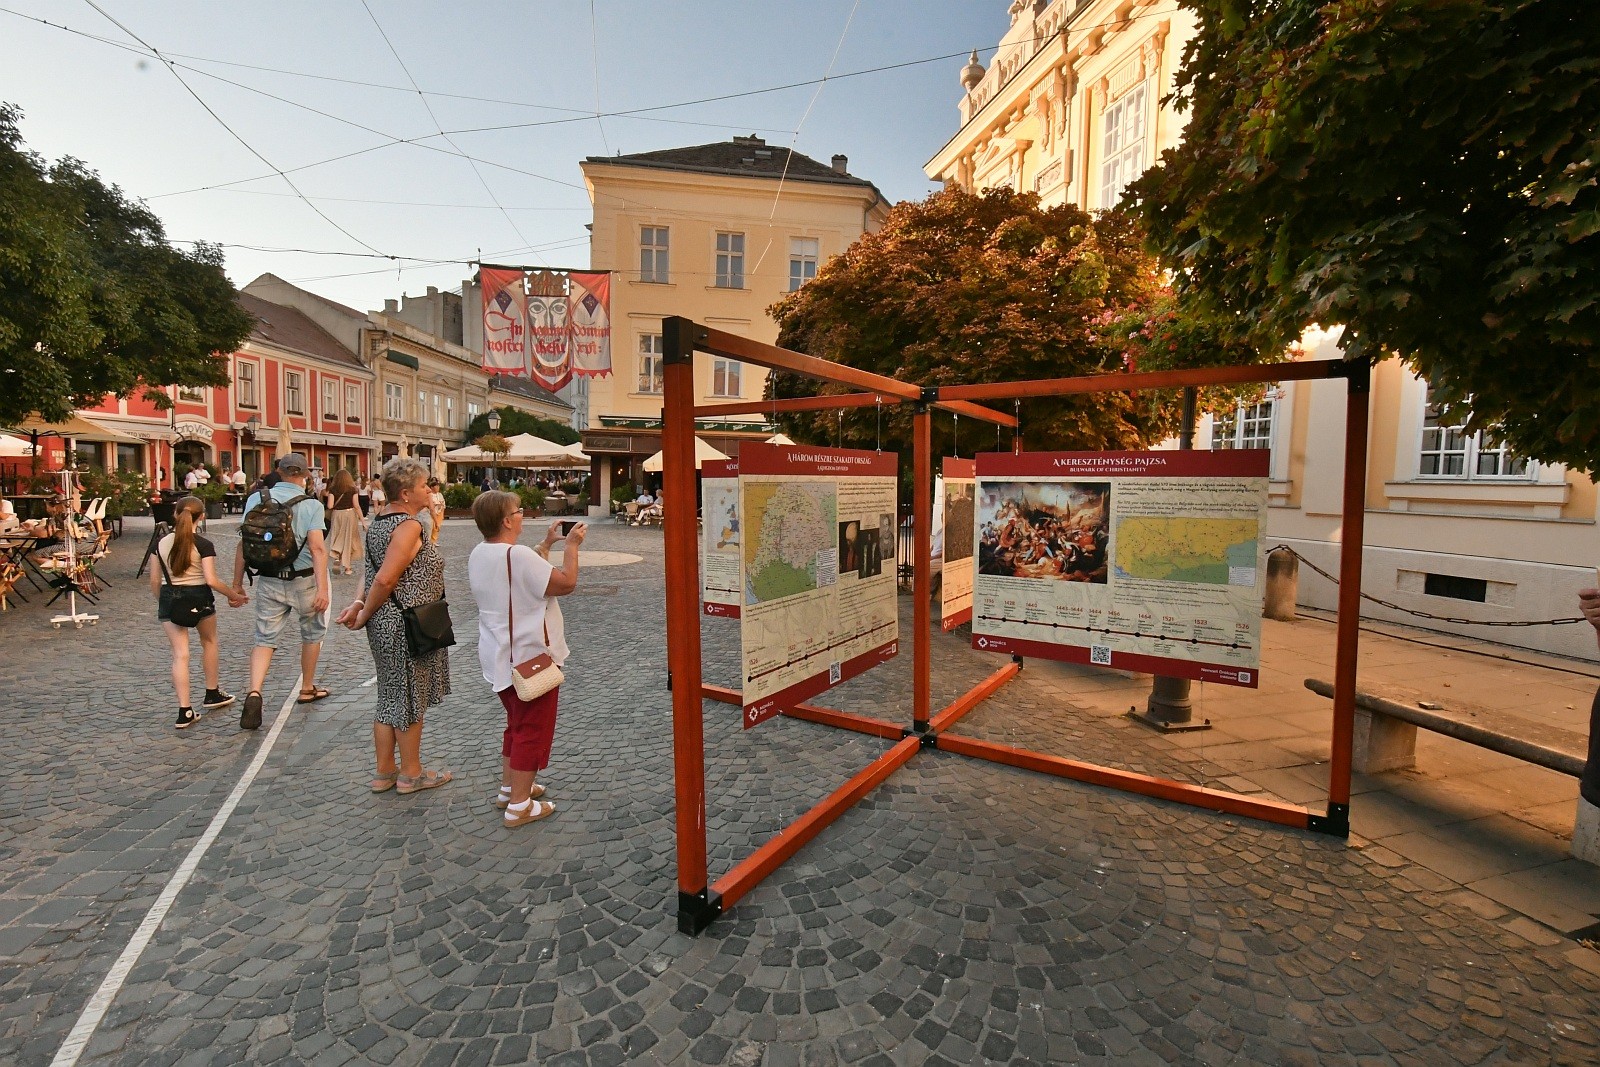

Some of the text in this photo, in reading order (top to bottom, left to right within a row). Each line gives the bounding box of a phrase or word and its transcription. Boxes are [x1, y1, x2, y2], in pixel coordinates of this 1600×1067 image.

[793, 452, 813, 462] HÁROM
[1053, 457, 1166, 467] A KERESZTÉNYSÉG PAJZSA
